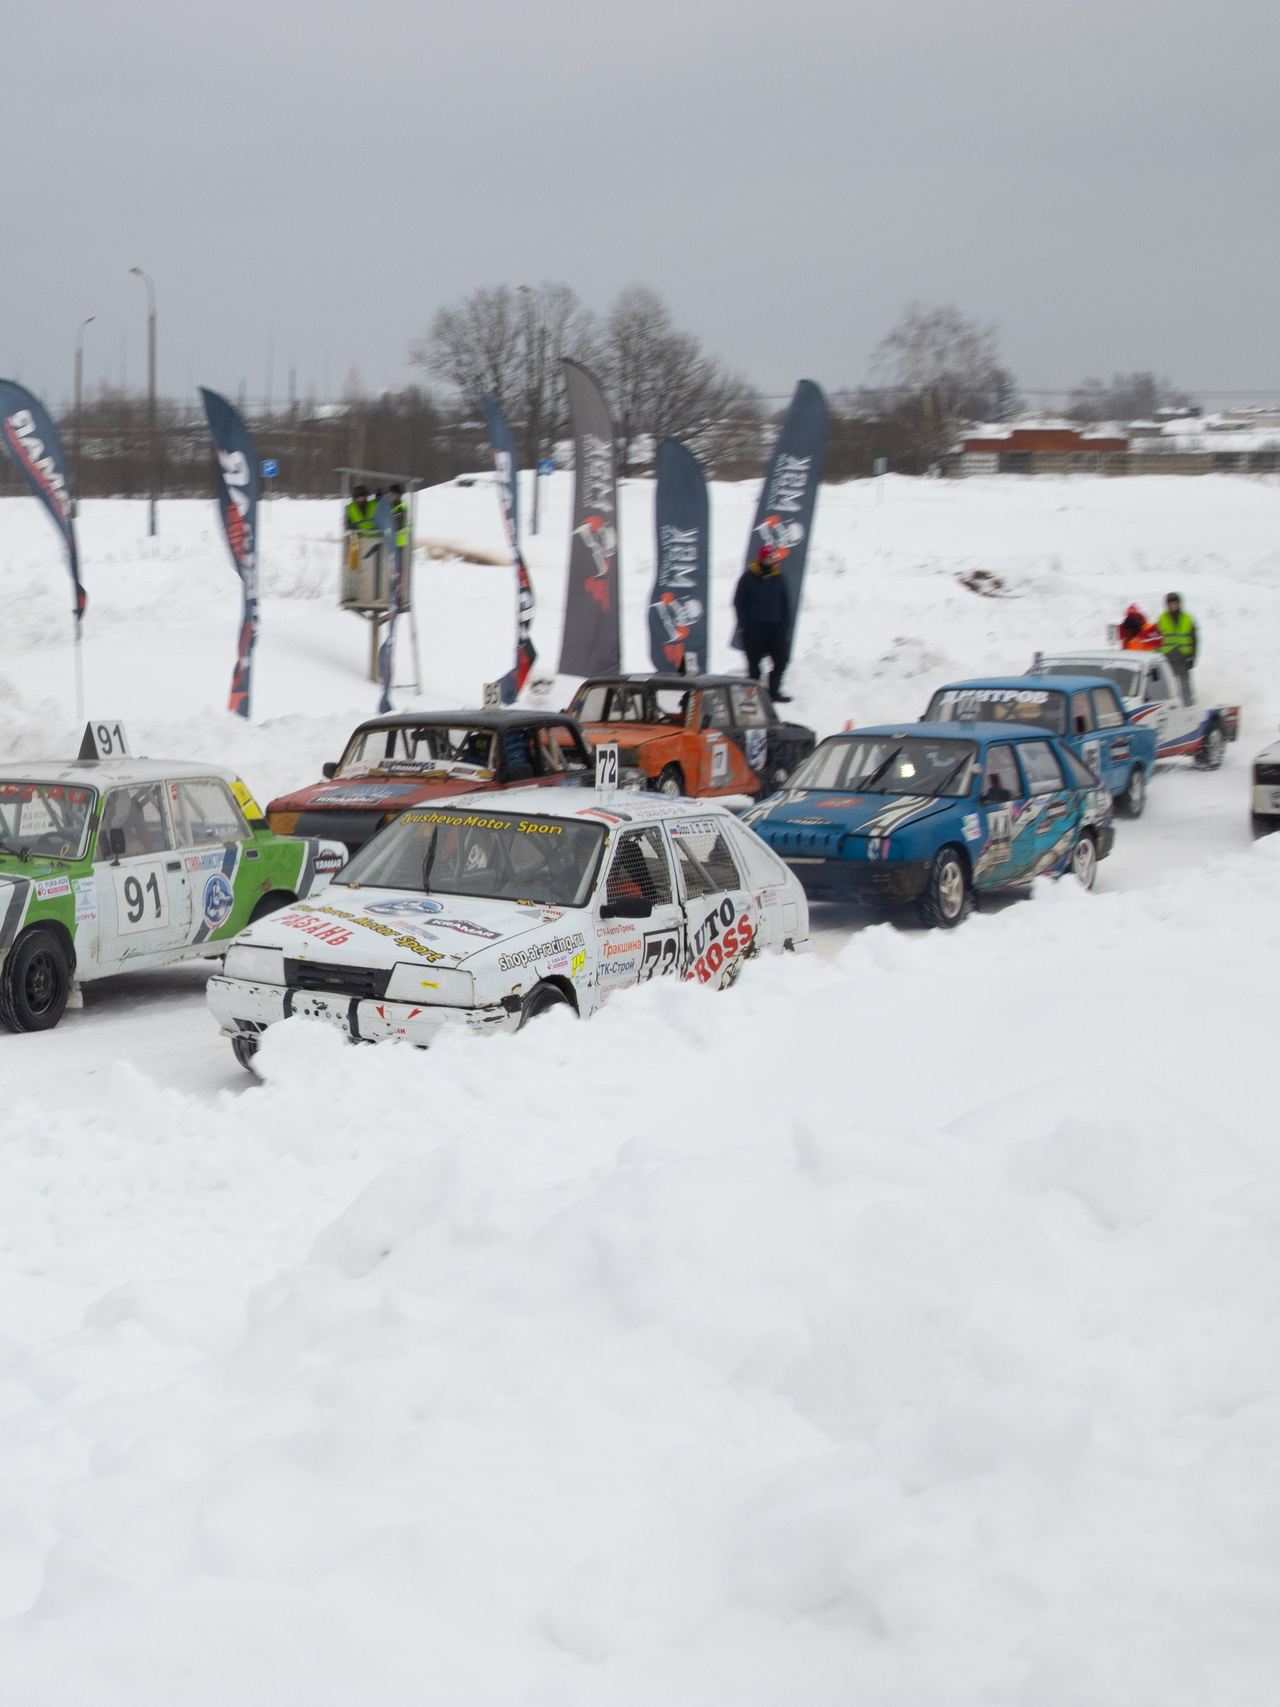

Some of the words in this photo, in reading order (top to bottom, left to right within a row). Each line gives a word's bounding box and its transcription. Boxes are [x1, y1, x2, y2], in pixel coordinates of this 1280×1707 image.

[97, 724, 125, 755] 91
[598, 749, 616, 784] 72
[463, 816, 511, 830] Motor
[124, 872, 162, 924] 91
[271, 914, 355, 946] РЯЗАНЬ
[350, 917, 401, 937] Motor
[394, 935, 446, 962] Sport
[432, 919, 495, 938] KRAMAR
[498, 932, 585, 971] shop.at-racing.ru
[602, 940, 641, 959] Тракшина
[644, 938, 677, 981] 72
[686, 914, 752, 984] ROSS
